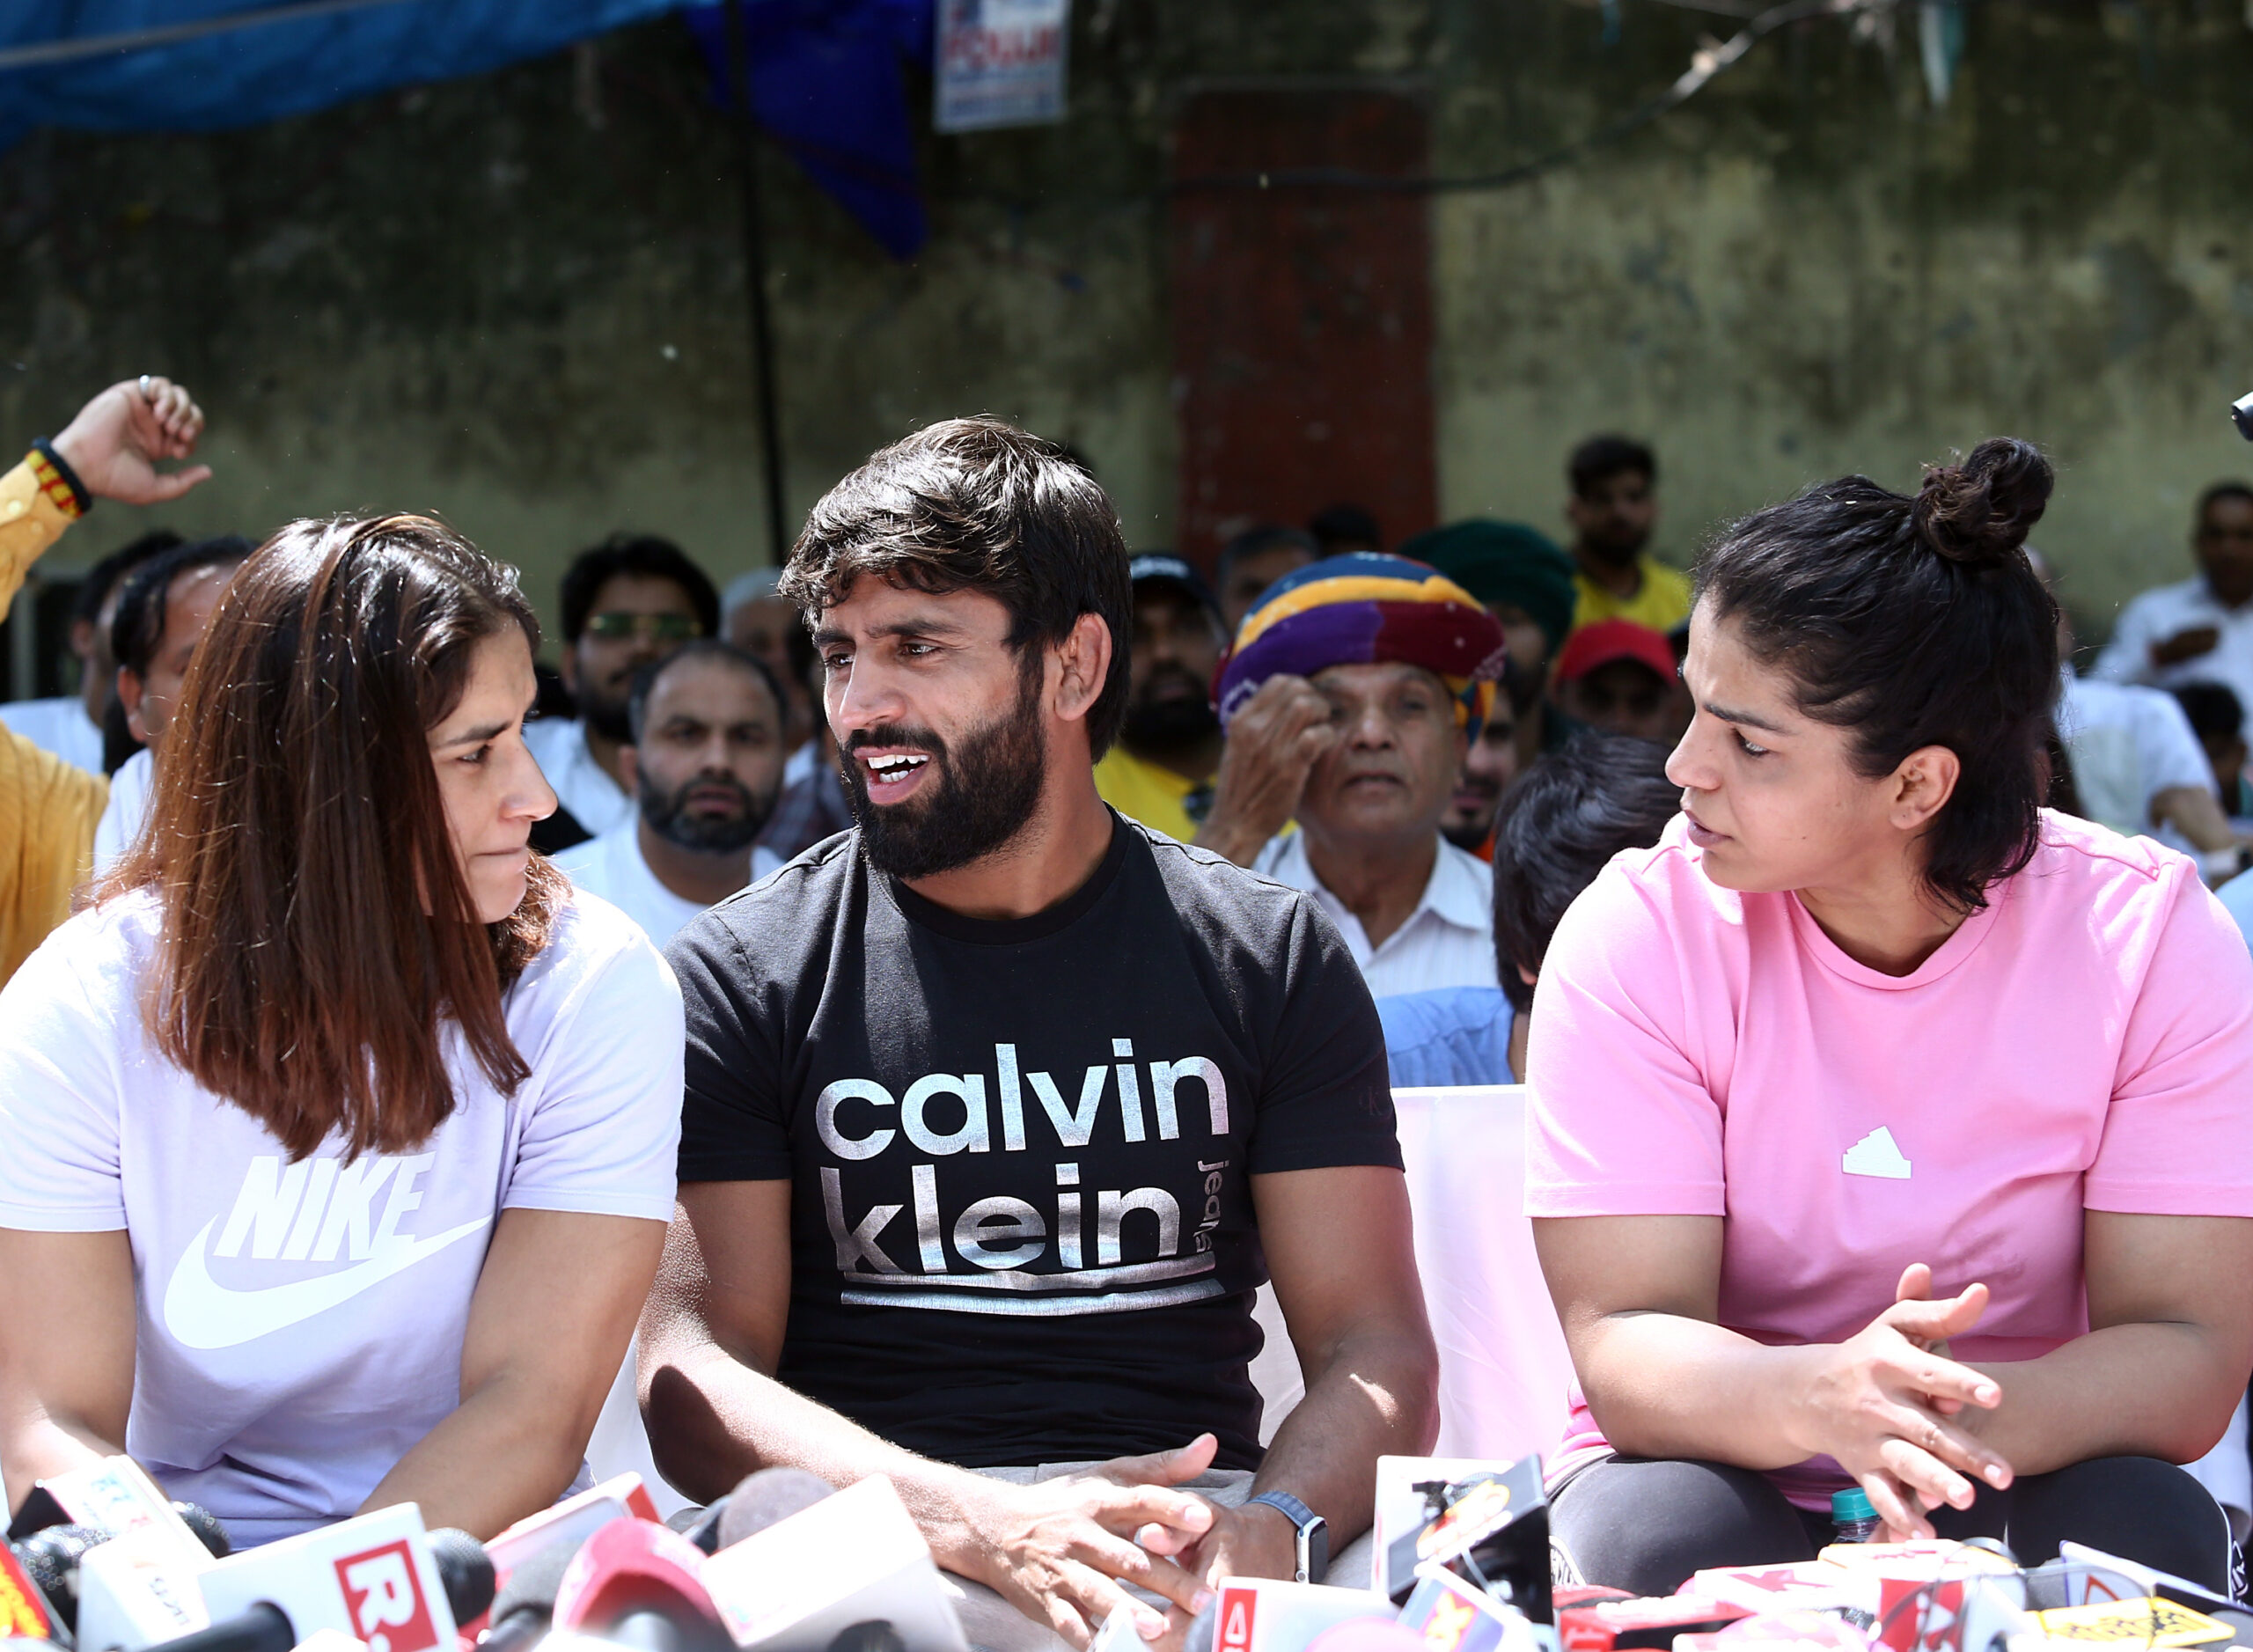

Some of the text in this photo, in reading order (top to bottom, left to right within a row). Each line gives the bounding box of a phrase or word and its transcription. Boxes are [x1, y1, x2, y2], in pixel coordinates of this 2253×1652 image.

[815, 1038, 1229, 1161] calvin
[212, 1150, 437, 1262] NIKE
[819, 1162, 1180, 1274] klein
